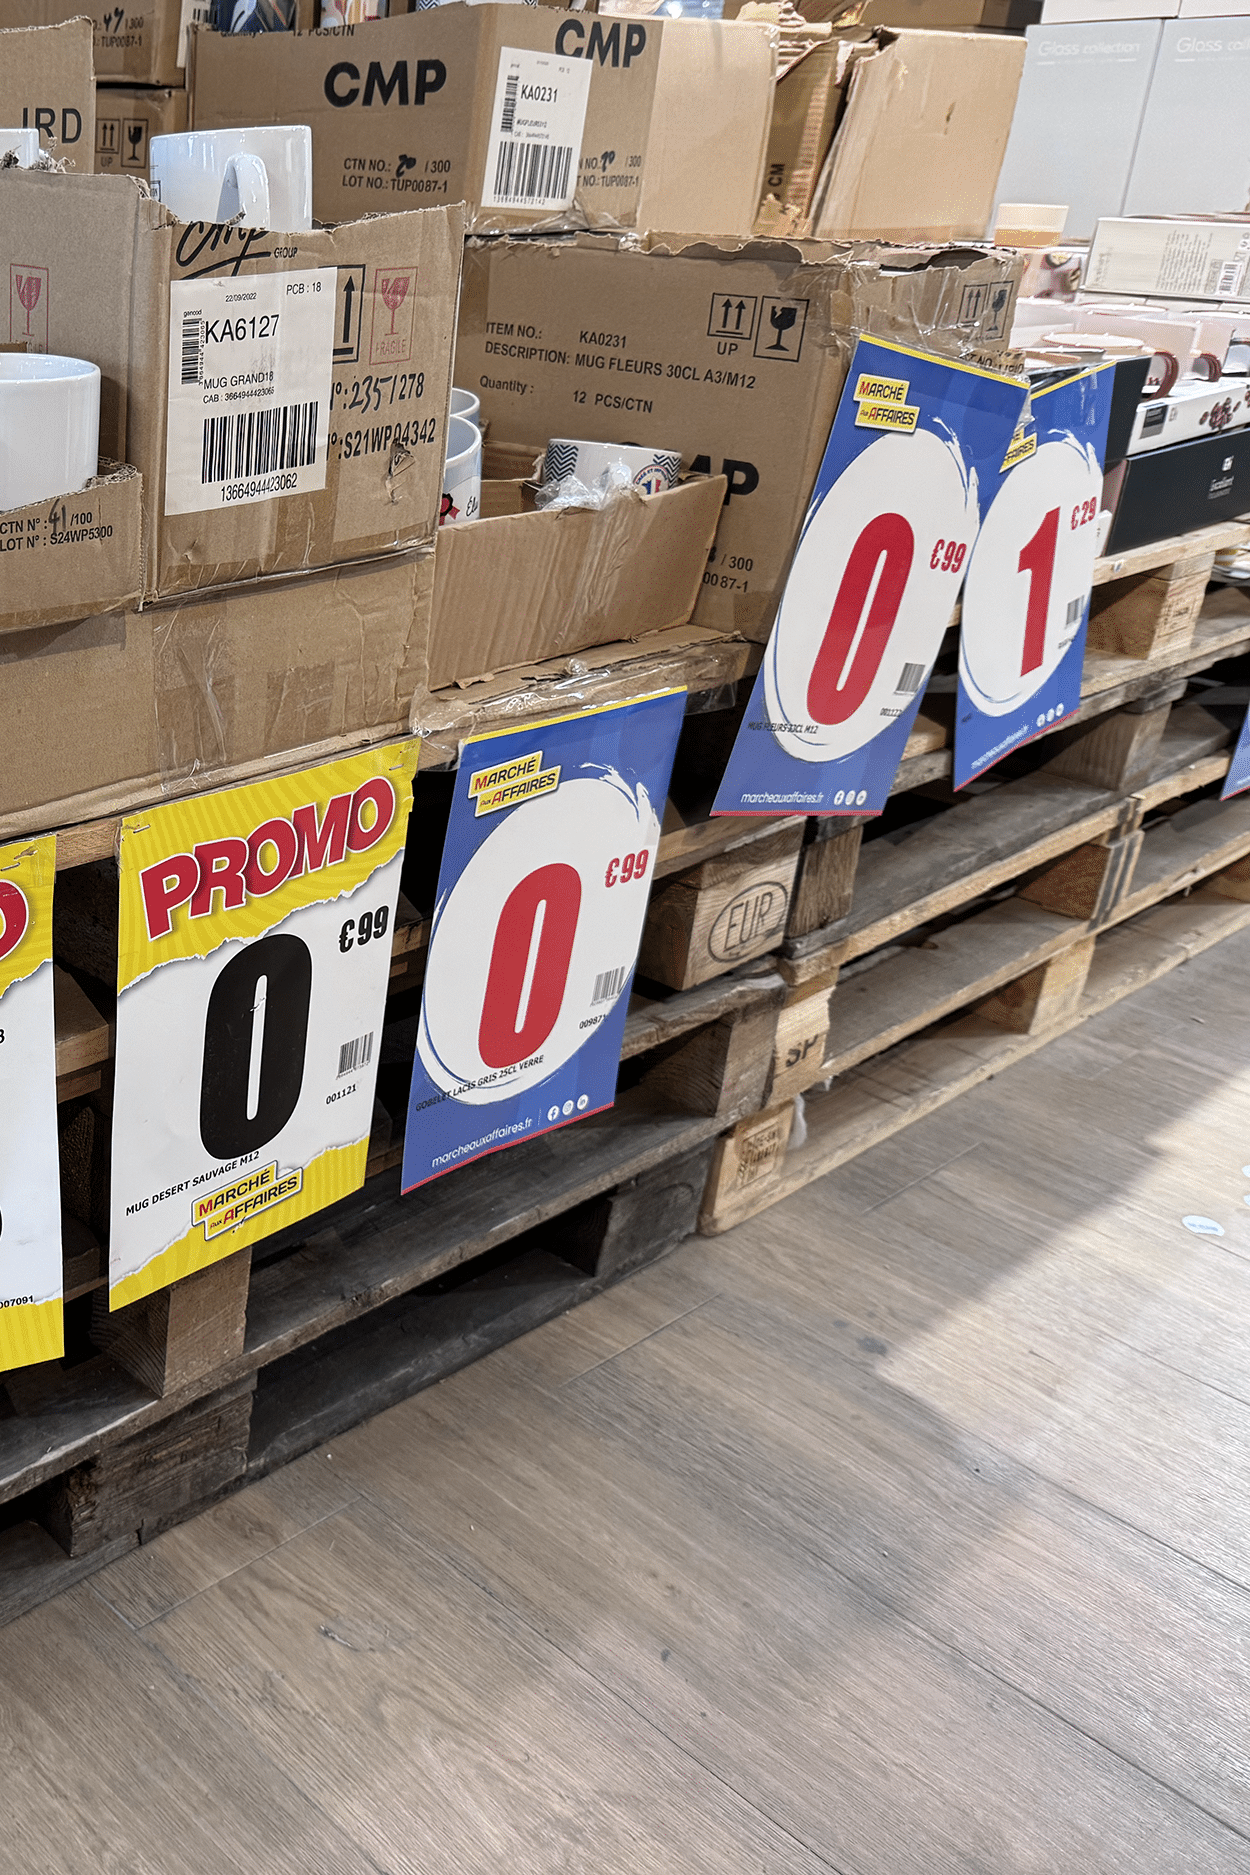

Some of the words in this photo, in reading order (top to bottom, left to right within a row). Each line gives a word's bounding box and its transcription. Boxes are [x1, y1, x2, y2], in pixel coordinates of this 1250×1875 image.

[554, 19, 647, 68] CMP
[1177, 37, 1222, 53] Glass
[323, 58, 447, 107] CMP
[520, 84, 558, 103] KA0231
[100, 157, 113, 168] UP
[343, 157, 366, 171] CTN
[369, 160, 391, 172] NO.:
[342, 175, 364, 188] LOT
[366, 177, 389, 189] NO.:
[390, 179, 448, 193] TUP0087-1
[274, 247, 298, 258] GROUP
[225, 292, 257, 302] 22/09/2022
[286, 283, 305, 295] PCB
[312, 282, 322, 293] 18
[205, 314, 279, 344] KA6127
[486, 322, 514, 337] ITEM
[517, 325, 542, 340] NO.:
[579, 330, 627, 348] KA0231
[717, 341, 738, 355] UP
[485, 341, 570, 365] DESCRIPTION:
[575, 354, 605, 369] MUG
[608, 357, 662, 376] FLEURS
[666, 364, 700, 381] 30CL
[704, 369, 756, 389] A3/M12
[204, 376, 228, 390] MUG
[230, 371, 274, 387] GRAND18
[859, 381, 904, 400] MARCHÉ
[203, 394, 219, 404] CAB
[573, 390, 586, 403] 12
[595, 393, 653, 413] PCS/CTN
[869, 407, 915, 425] AFFAIRES
[221, 472, 298, 501] 13664944423062
[0, 520, 23, 535] CTN
[70, 512, 93, 526] /100
[0, 537, 23, 552] LOT
[50, 525, 113, 545] S24WP5300
[1017, 506, 1061, 677] 1
[807, 512, 915, 726] 0
[475, 757, 537, 790] MARCHÉ
[492, 773, 556, 805] AFFAIRES
[140, 776, 395, 941] PROMO
[724, 891, 774, 951] EUP
[478, 863, 582, 1069] 0
[200, 933, 312, 1160] 0
[477, 1072, 498, 1086] GRIS
[499, 1066, 517, 1079] 25CL
[519, 1054, 545, 1070] VERRE
[326, 1083, 356, 1105] 001121
[432, 1117, 532, 1168] marcheauxaffaires.fr
[125, 1199, 149, 1216] MUG
[152, 1180, 190, 1205] DESERT
[192, 1160, 237, 1187] SAUVAGE
[240, 1151, 260, 1166] M12
[199, 1169, 270, 1217] MARCHÉ
[223, 1176, 297, 1225] AFFAIRES
